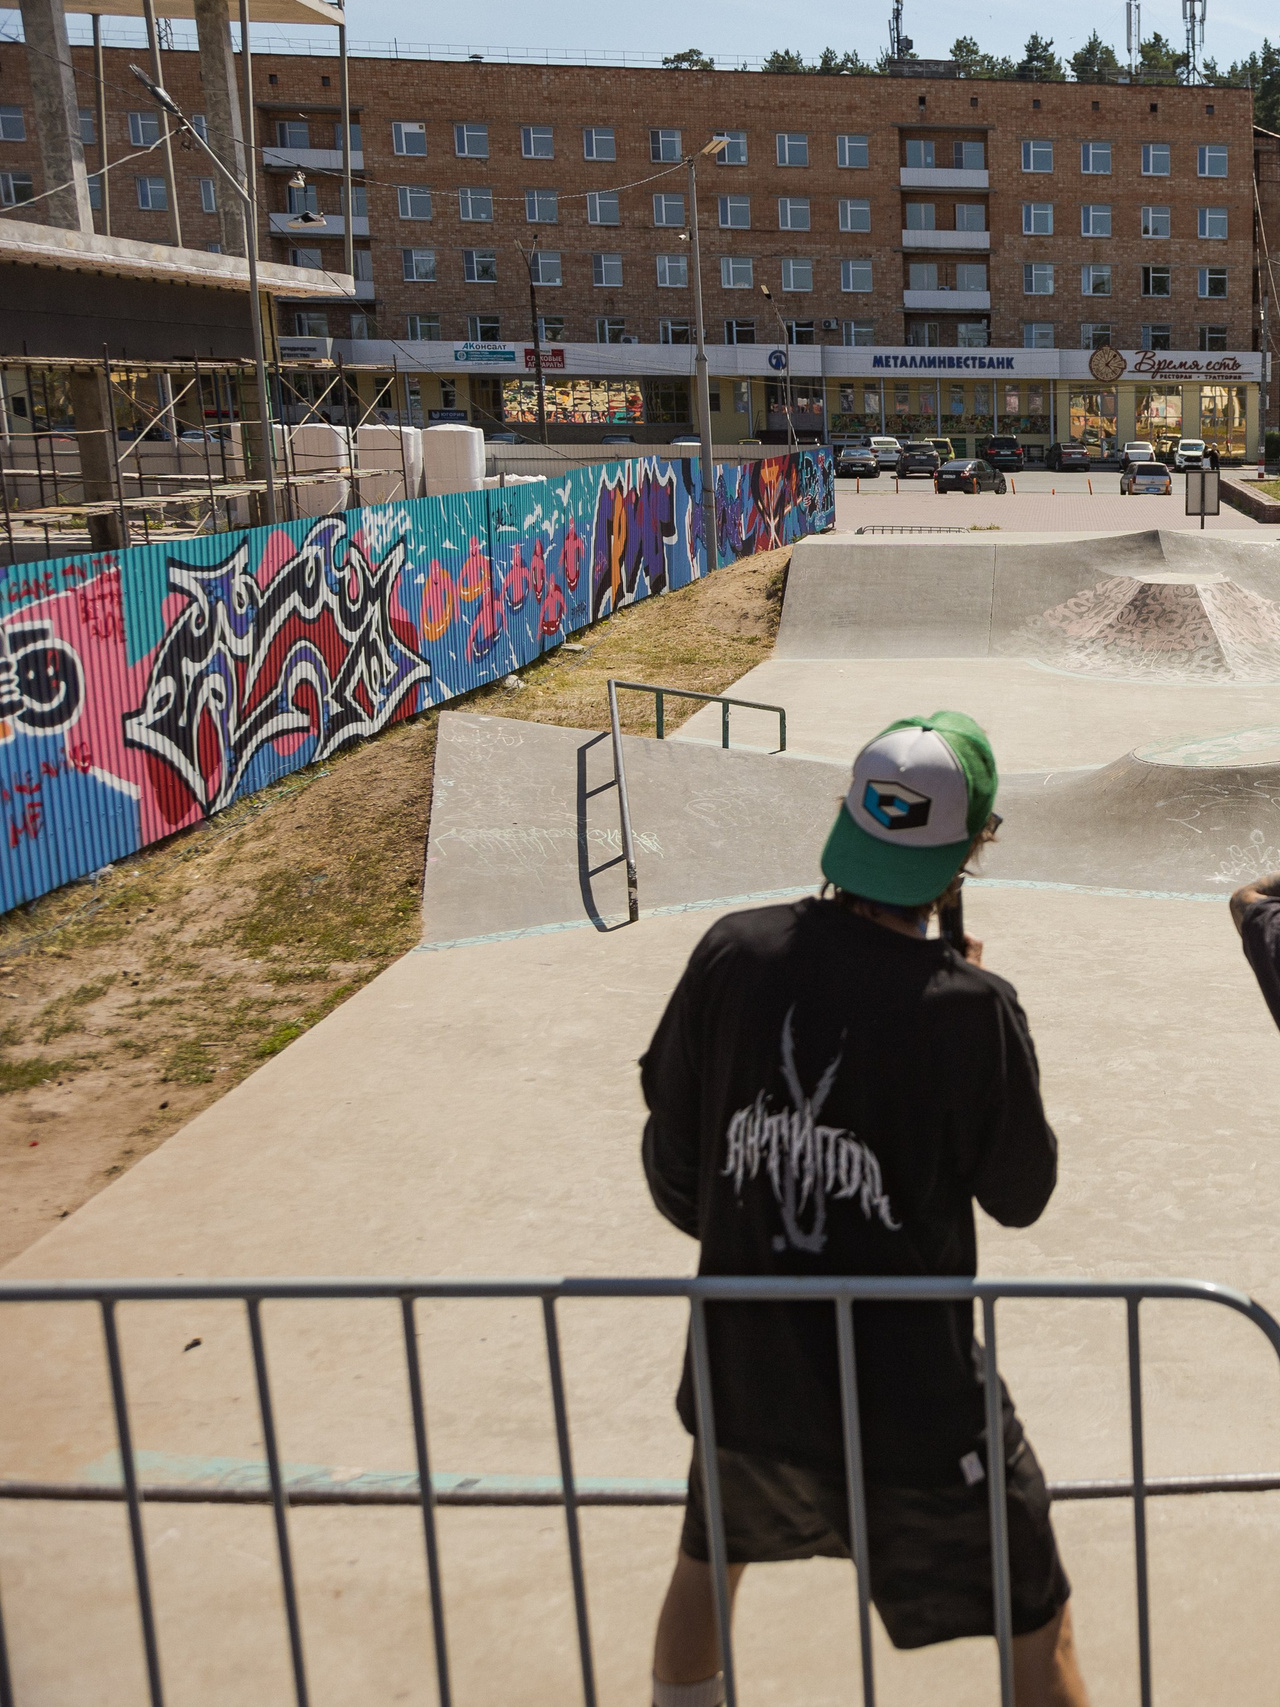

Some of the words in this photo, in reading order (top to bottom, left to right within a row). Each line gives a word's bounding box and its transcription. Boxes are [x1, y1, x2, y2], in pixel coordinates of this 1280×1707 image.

[872, 355, 1015, 369] МЕТАЛЛИНВЕСТБАНК
[1134, 350, 1204, 379] Время
[1206, 356, 1242, 371] есть
